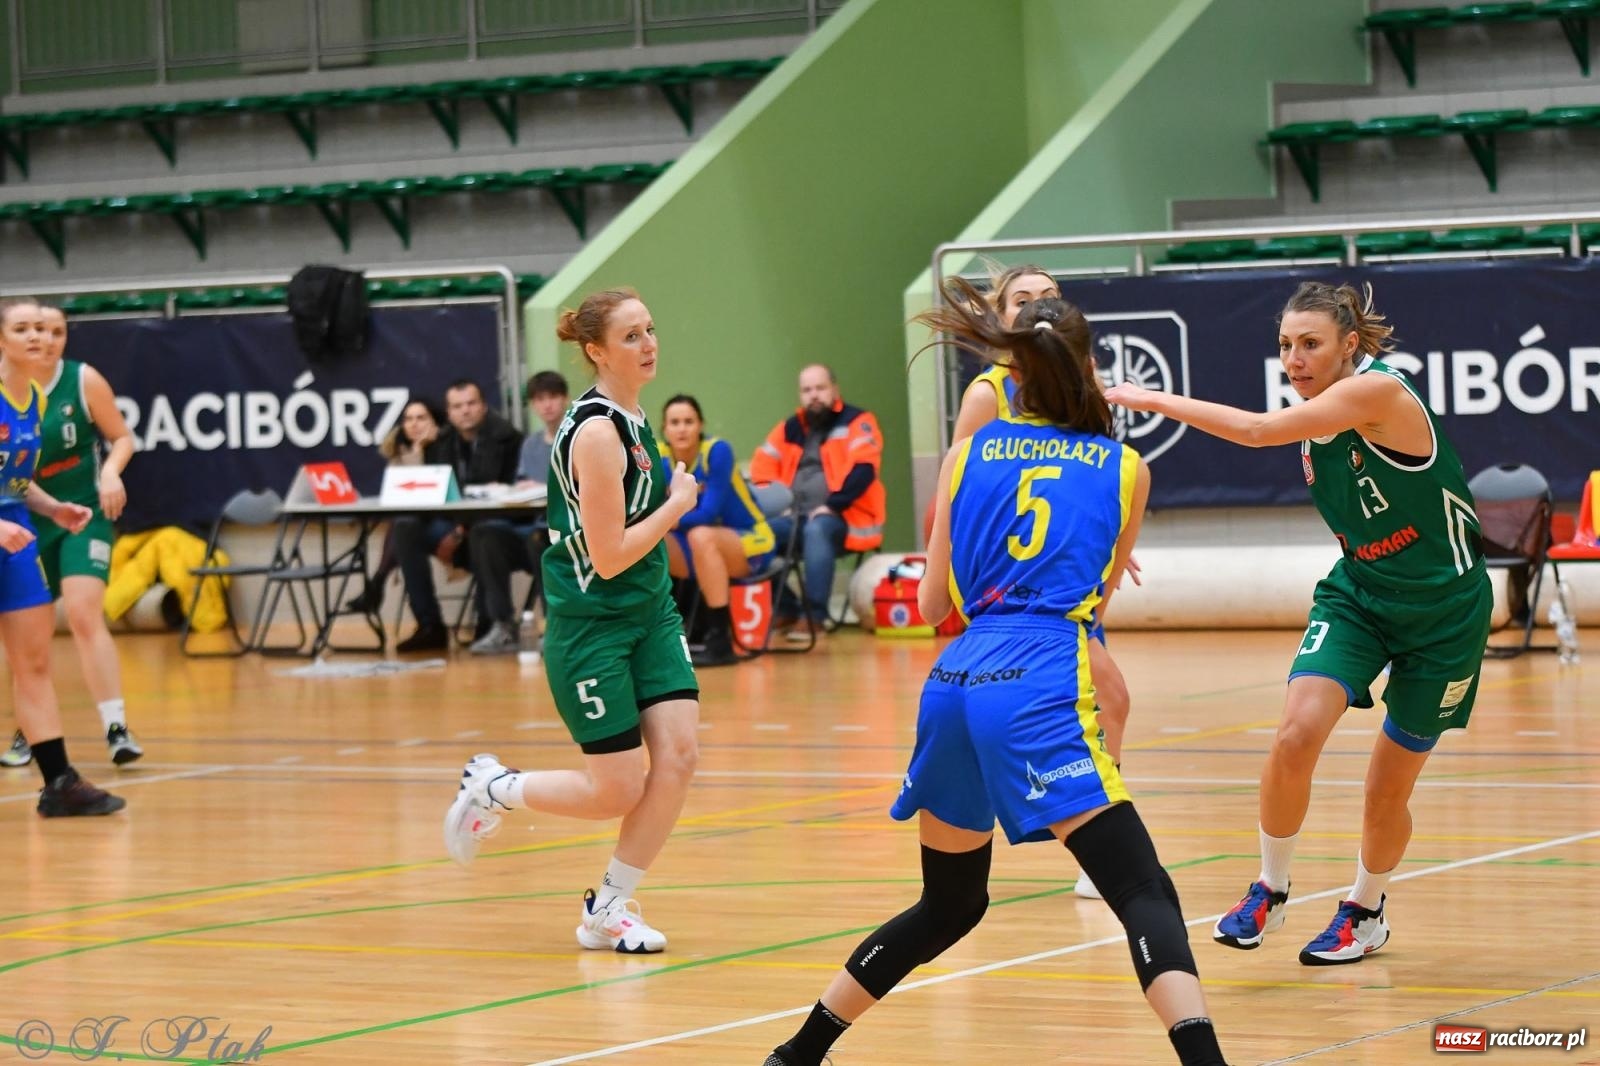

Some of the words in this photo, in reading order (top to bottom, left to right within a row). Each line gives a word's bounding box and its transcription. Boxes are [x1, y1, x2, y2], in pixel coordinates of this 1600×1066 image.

[62, 422, 77, 449] 9
[982, 437, 1111, 469] GŁUCHOŁAZY
[1007, 465, 1062, 561] 5
[739, 585, 763, 631] 5
[969, 667, 1027, 687] decor
[576, 678, 606, 719] 5
[1041, 759, 1092, 782] OPOLSKIE
